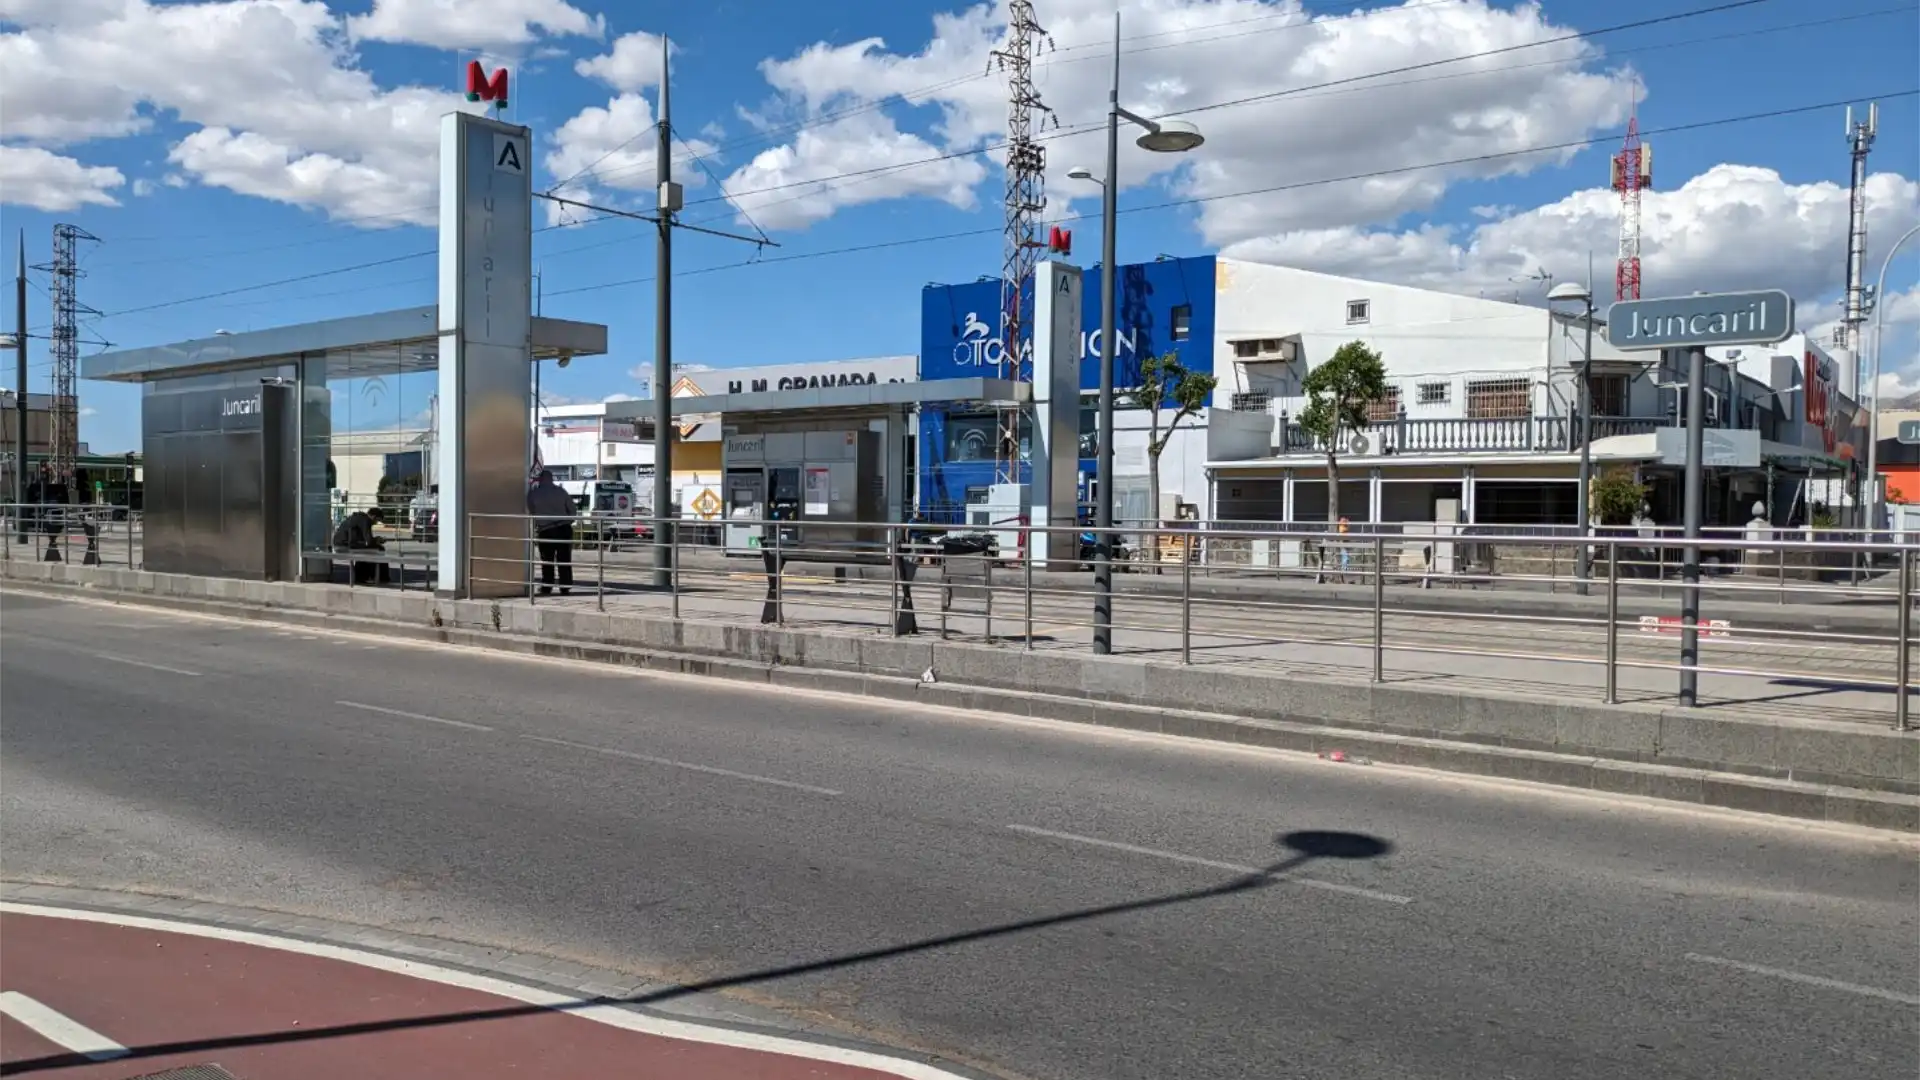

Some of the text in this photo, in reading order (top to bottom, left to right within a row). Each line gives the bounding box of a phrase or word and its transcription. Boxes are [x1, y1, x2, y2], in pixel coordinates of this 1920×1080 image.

[466, 60, 508, 107] M
[1625, 301, 1767, 340] Juncaril
[221, 395, 262, 417] Juncaril
